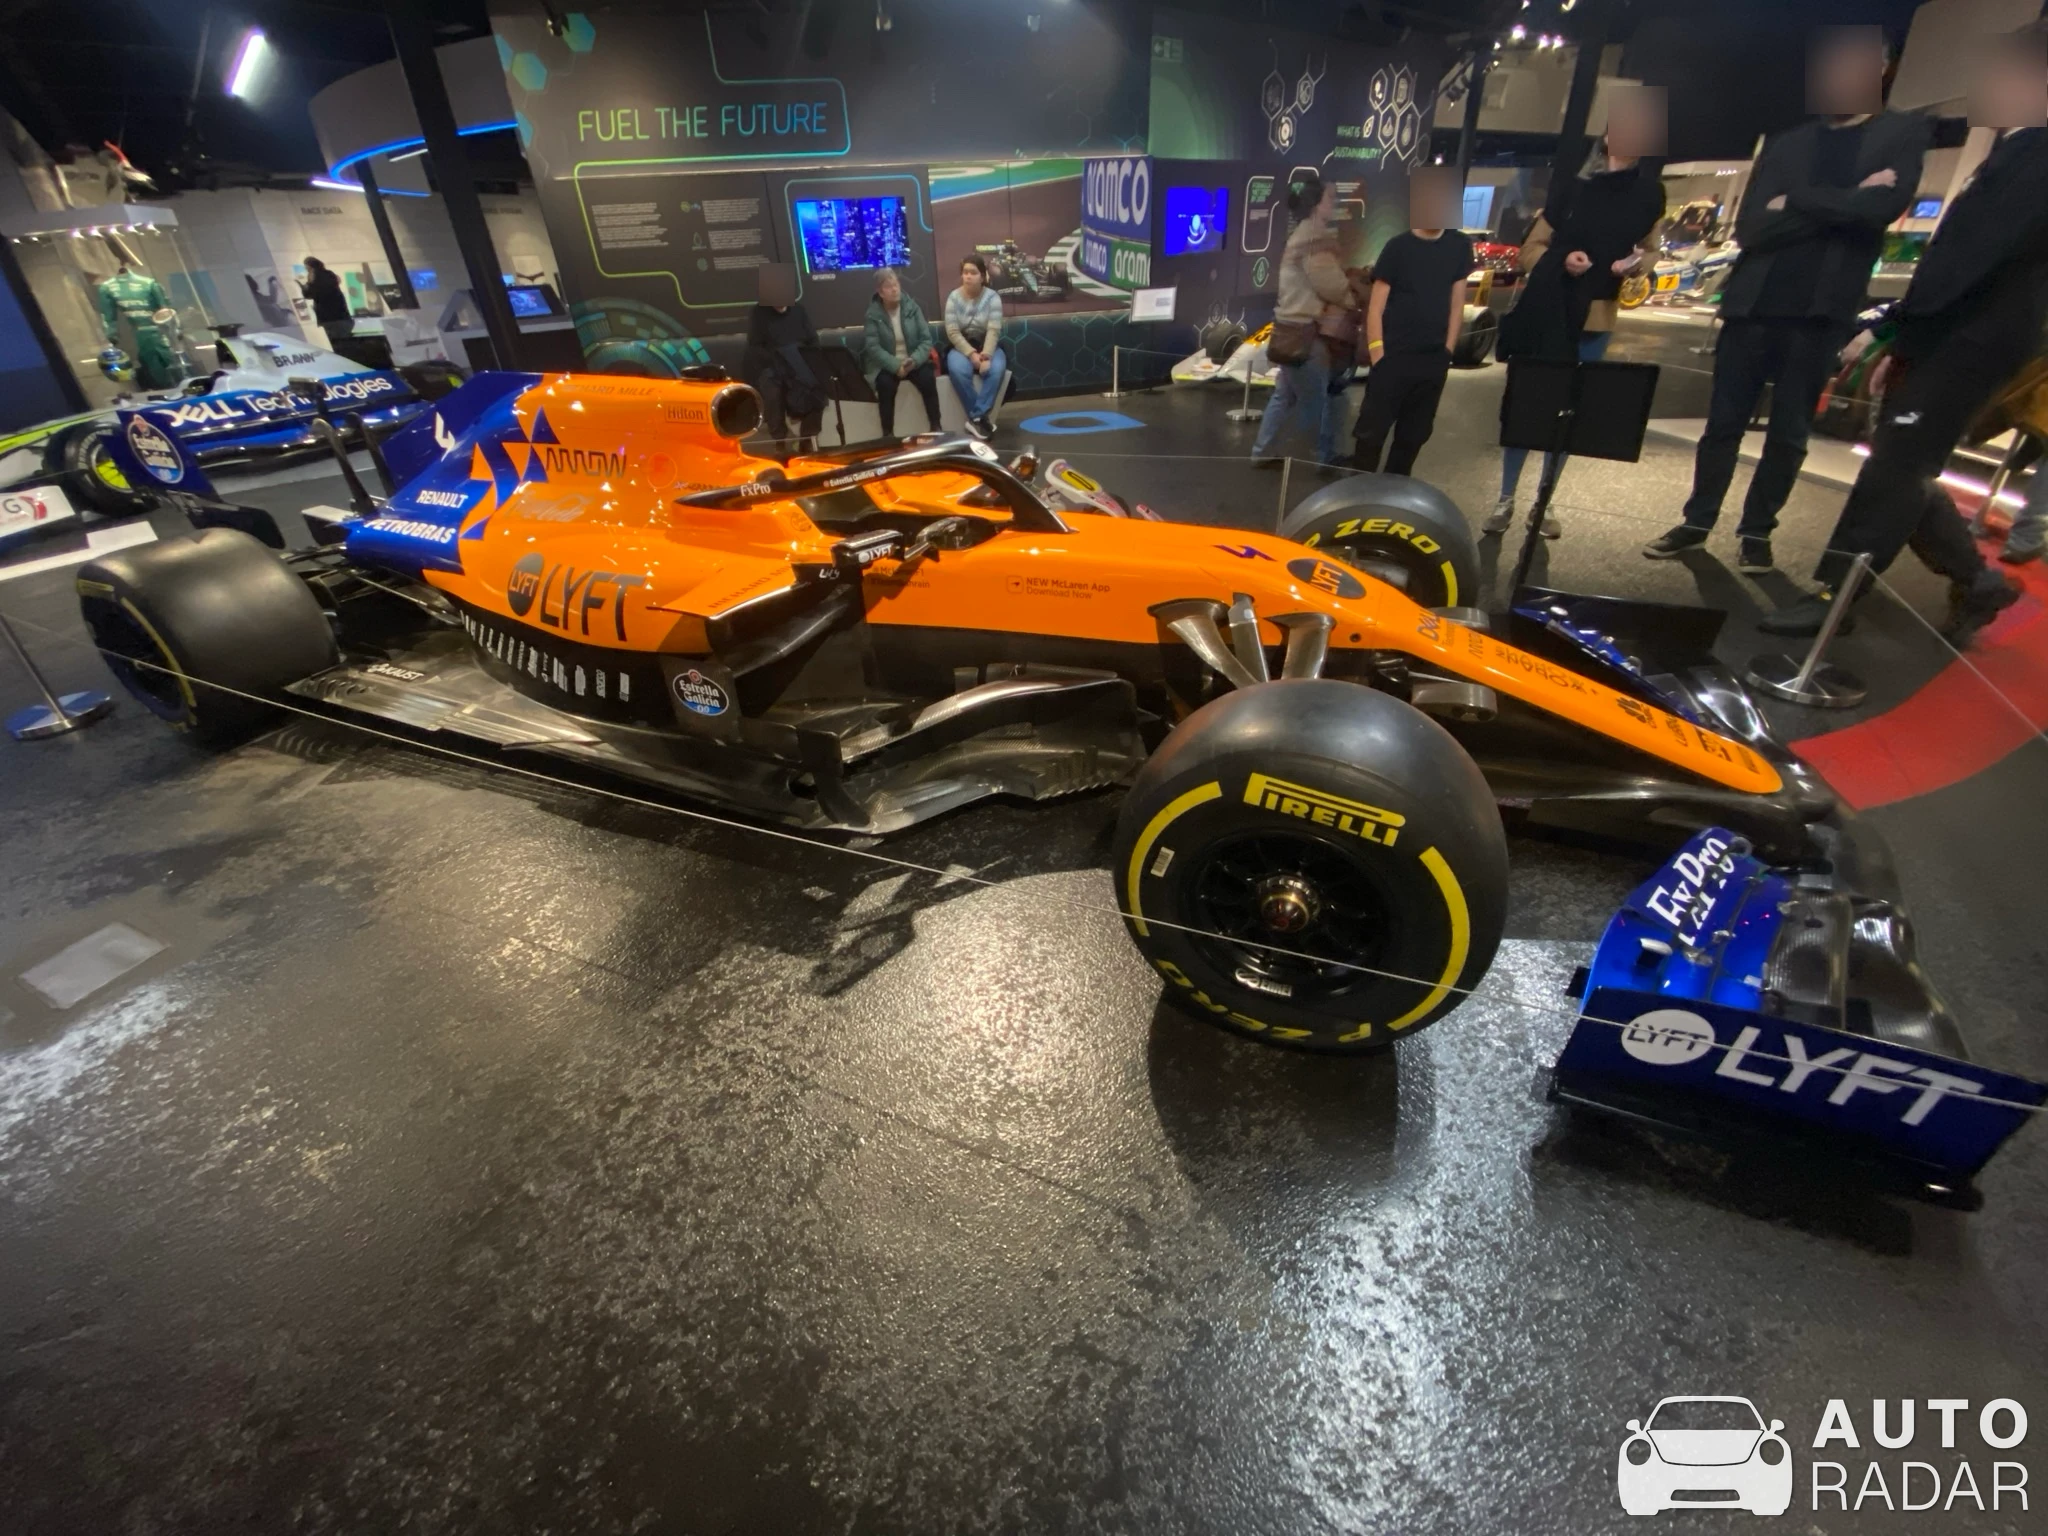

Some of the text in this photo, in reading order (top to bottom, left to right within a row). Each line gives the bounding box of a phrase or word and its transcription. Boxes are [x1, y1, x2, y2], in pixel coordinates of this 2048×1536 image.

[578, 102, 828, 142] FUEL THE FUTURE
[1337, 126, 1354, 136] WHAT
[1087, 159, 1149, 225] aramco
[1114, 249, 1151, 287] aram
[272, 353, 316, 368] BRAWN
[154, 401, 247, 427] DELL
[667, 405, 704, 420] Hilton
[546, 447, 627, 478] ARROW
[416, 490, 469, 508] RENAULT
[740, 483, 771, 497] FxPro
[364, 519, 457, 544] PETROBRAS
[1334, 518, 1441, 554] ZERO
[1026, 577, 1111, 593] NEW McLaren App
[1026, 586, 1093, 599] Download Now
[510, 563, 647, 642] LYFT LYFT
[679, 679, 720, 697] Estrella
[684, 691, 720, 708] Galicia
[1243, 772, 1406, 847] PIRELLI
[1626, 1021, 1985, 1127] LYFT LYFT
